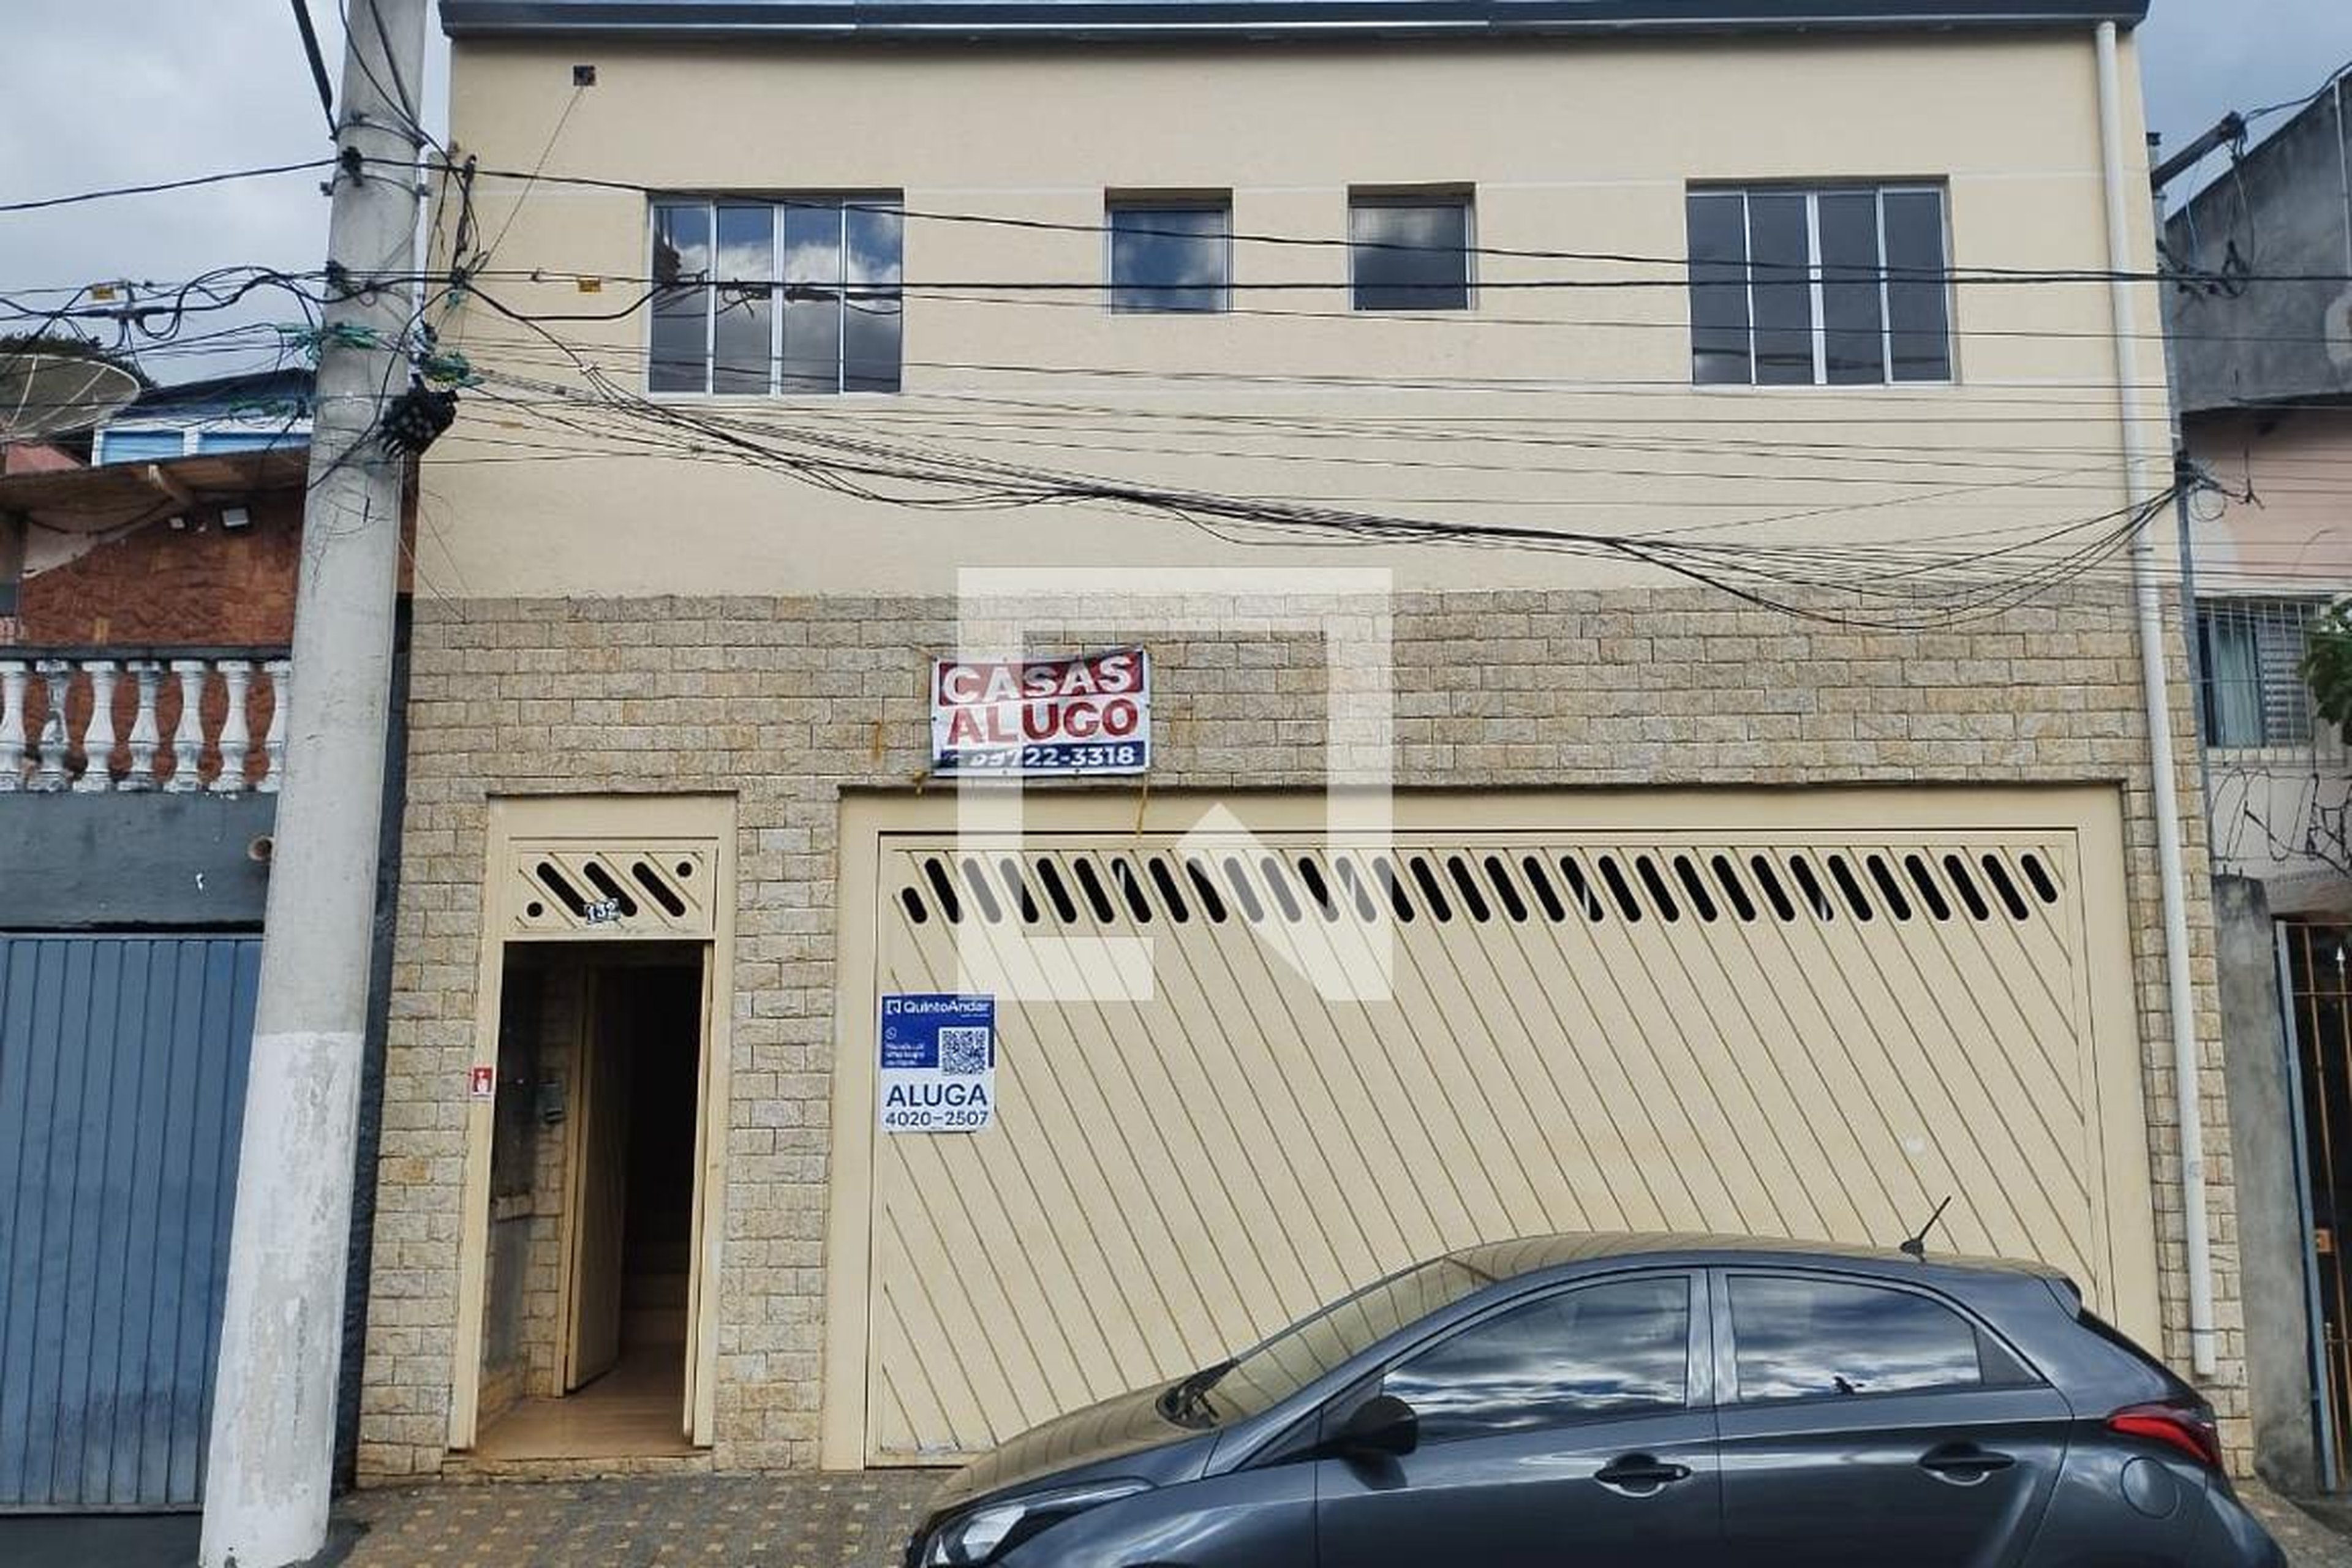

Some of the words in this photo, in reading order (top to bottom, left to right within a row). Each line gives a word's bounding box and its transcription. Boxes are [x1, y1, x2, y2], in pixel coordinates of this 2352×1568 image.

[942, 655, 1133, 703] CASAS
[947, 699, 1138, 745] ALUGO
[886, 1084, 987, 1107] ALUGA
[886, 1111, 988, 1126] 4020-2507
